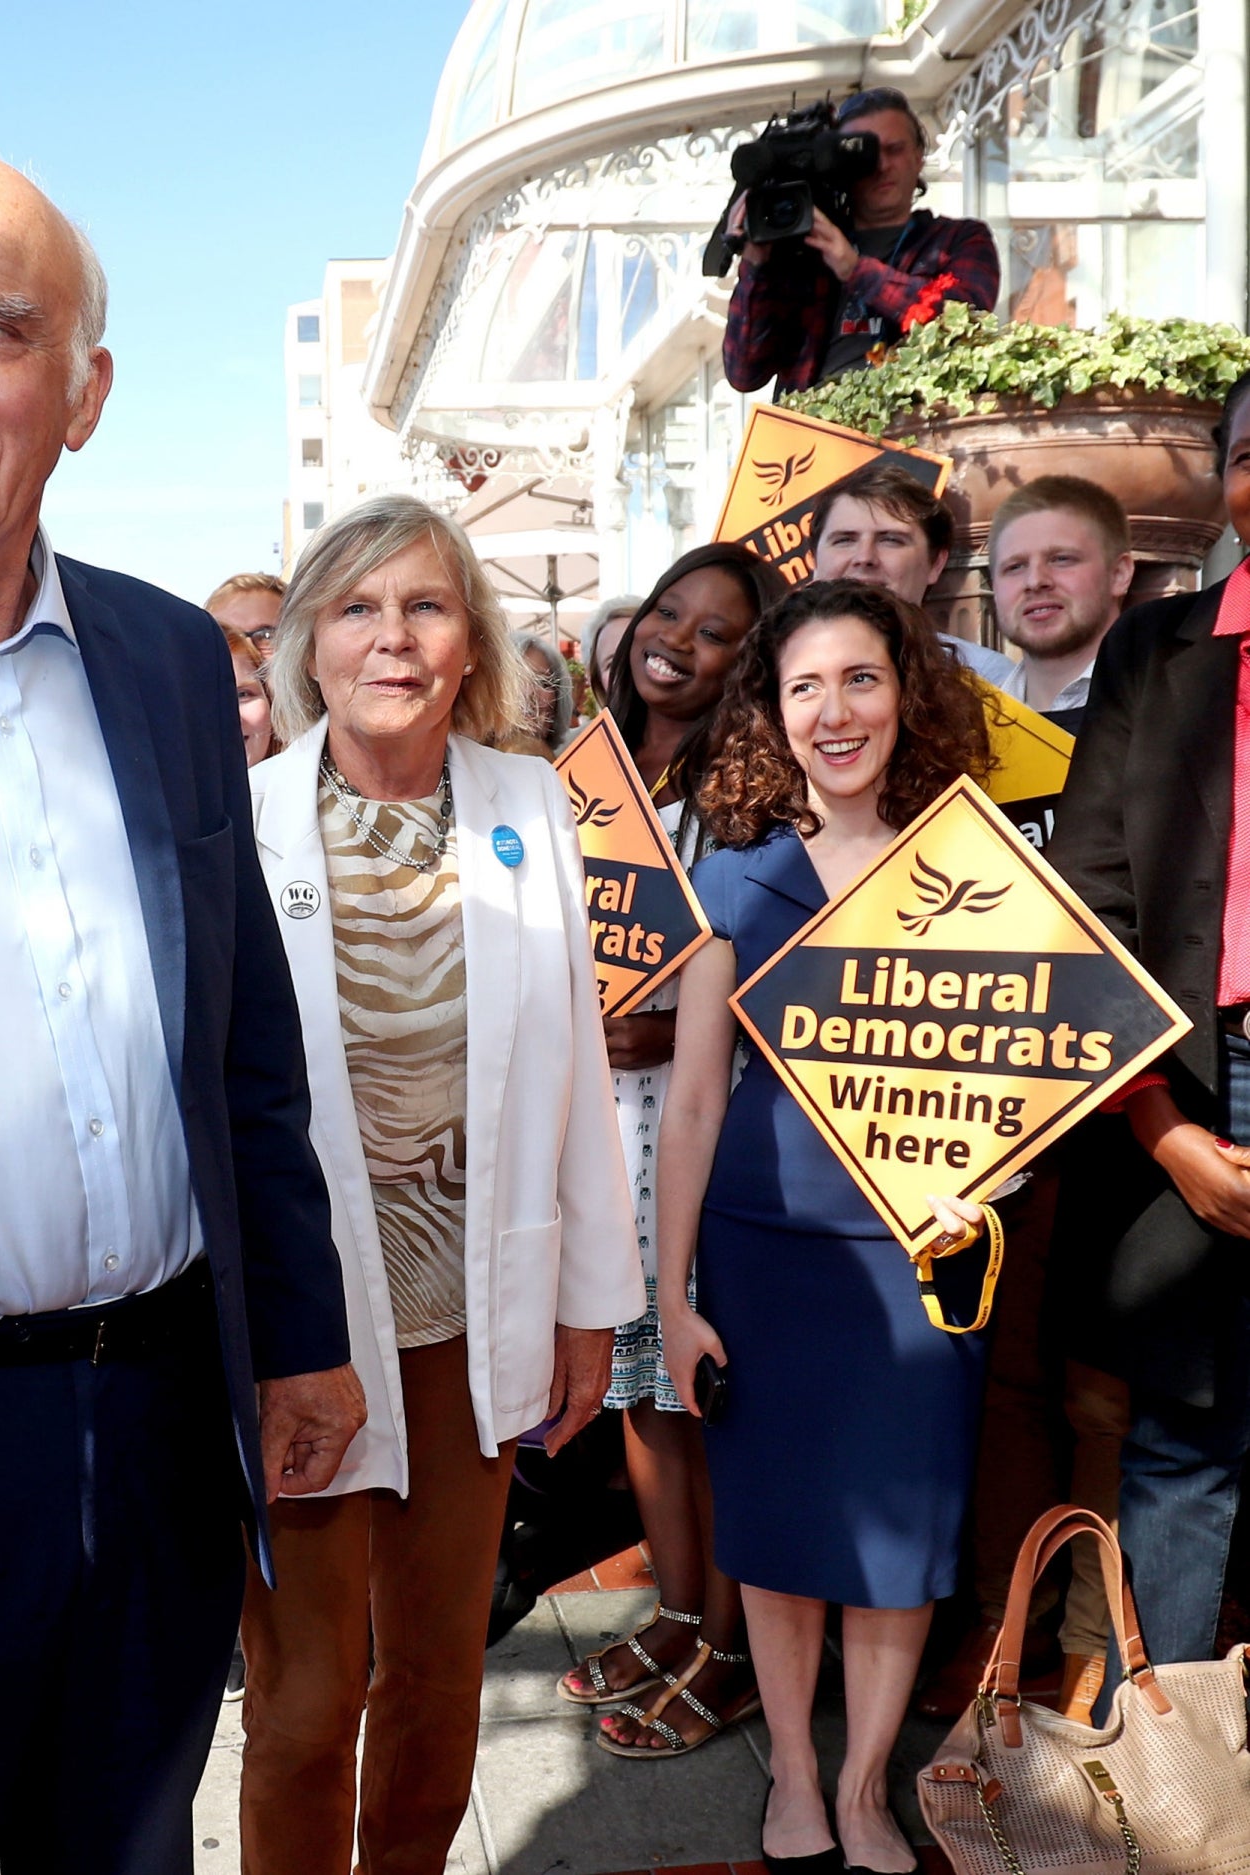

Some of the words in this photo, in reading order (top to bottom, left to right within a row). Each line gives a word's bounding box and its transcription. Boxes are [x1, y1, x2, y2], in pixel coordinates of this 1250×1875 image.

[840, 956, 1052, 1014] Liberal
[780, 1004, 1114, 1072] Democrats
[829, 1074, 1026, 1137] Winning
[865, 1121, 971, 1169] here
